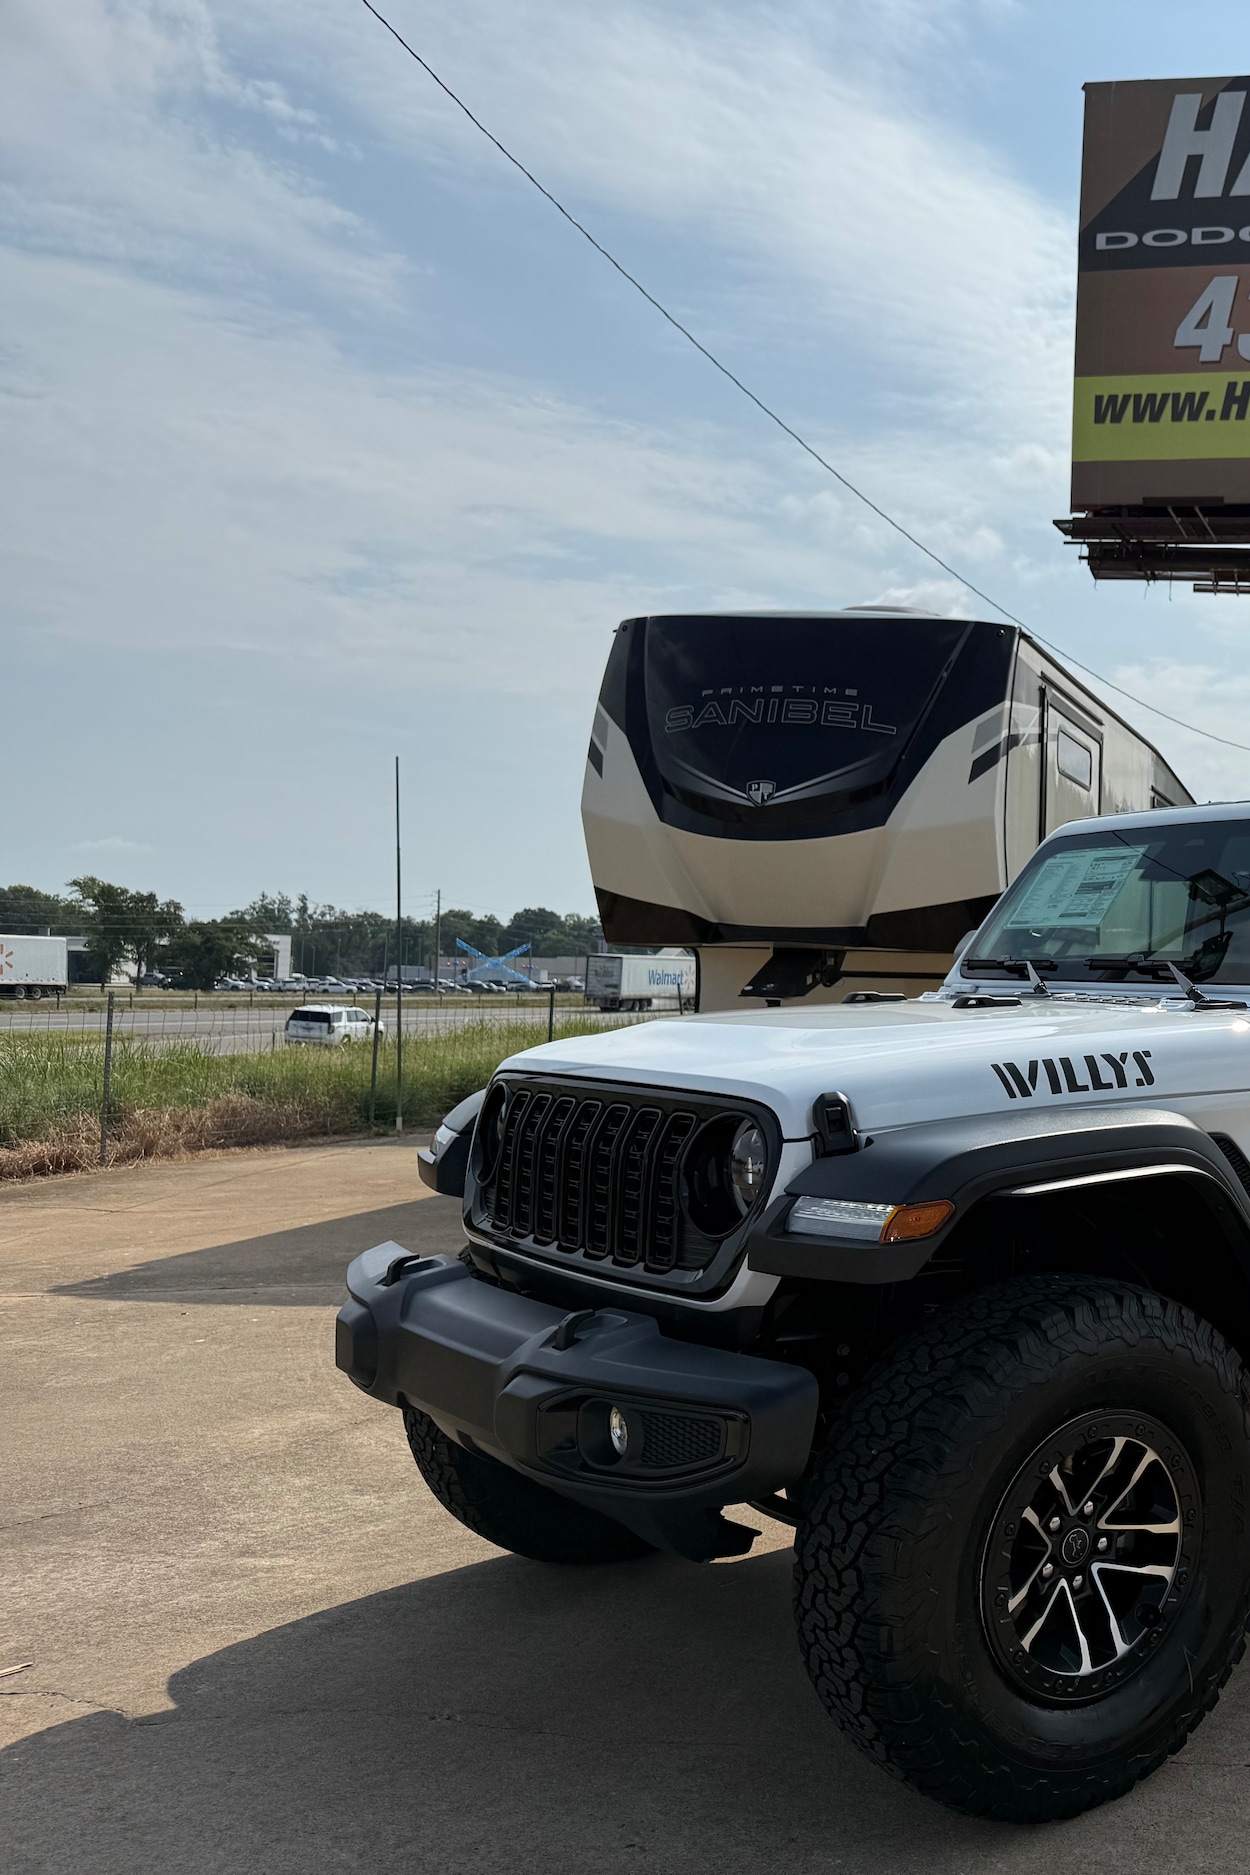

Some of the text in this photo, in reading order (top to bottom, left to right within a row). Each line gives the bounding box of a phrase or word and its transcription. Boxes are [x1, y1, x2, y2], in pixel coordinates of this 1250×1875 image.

[664, 698, 897, 735] SANIBEL
[648, 969, 684, 986] Walmart
[990, 1050, 1155, 1099] WILLYS
